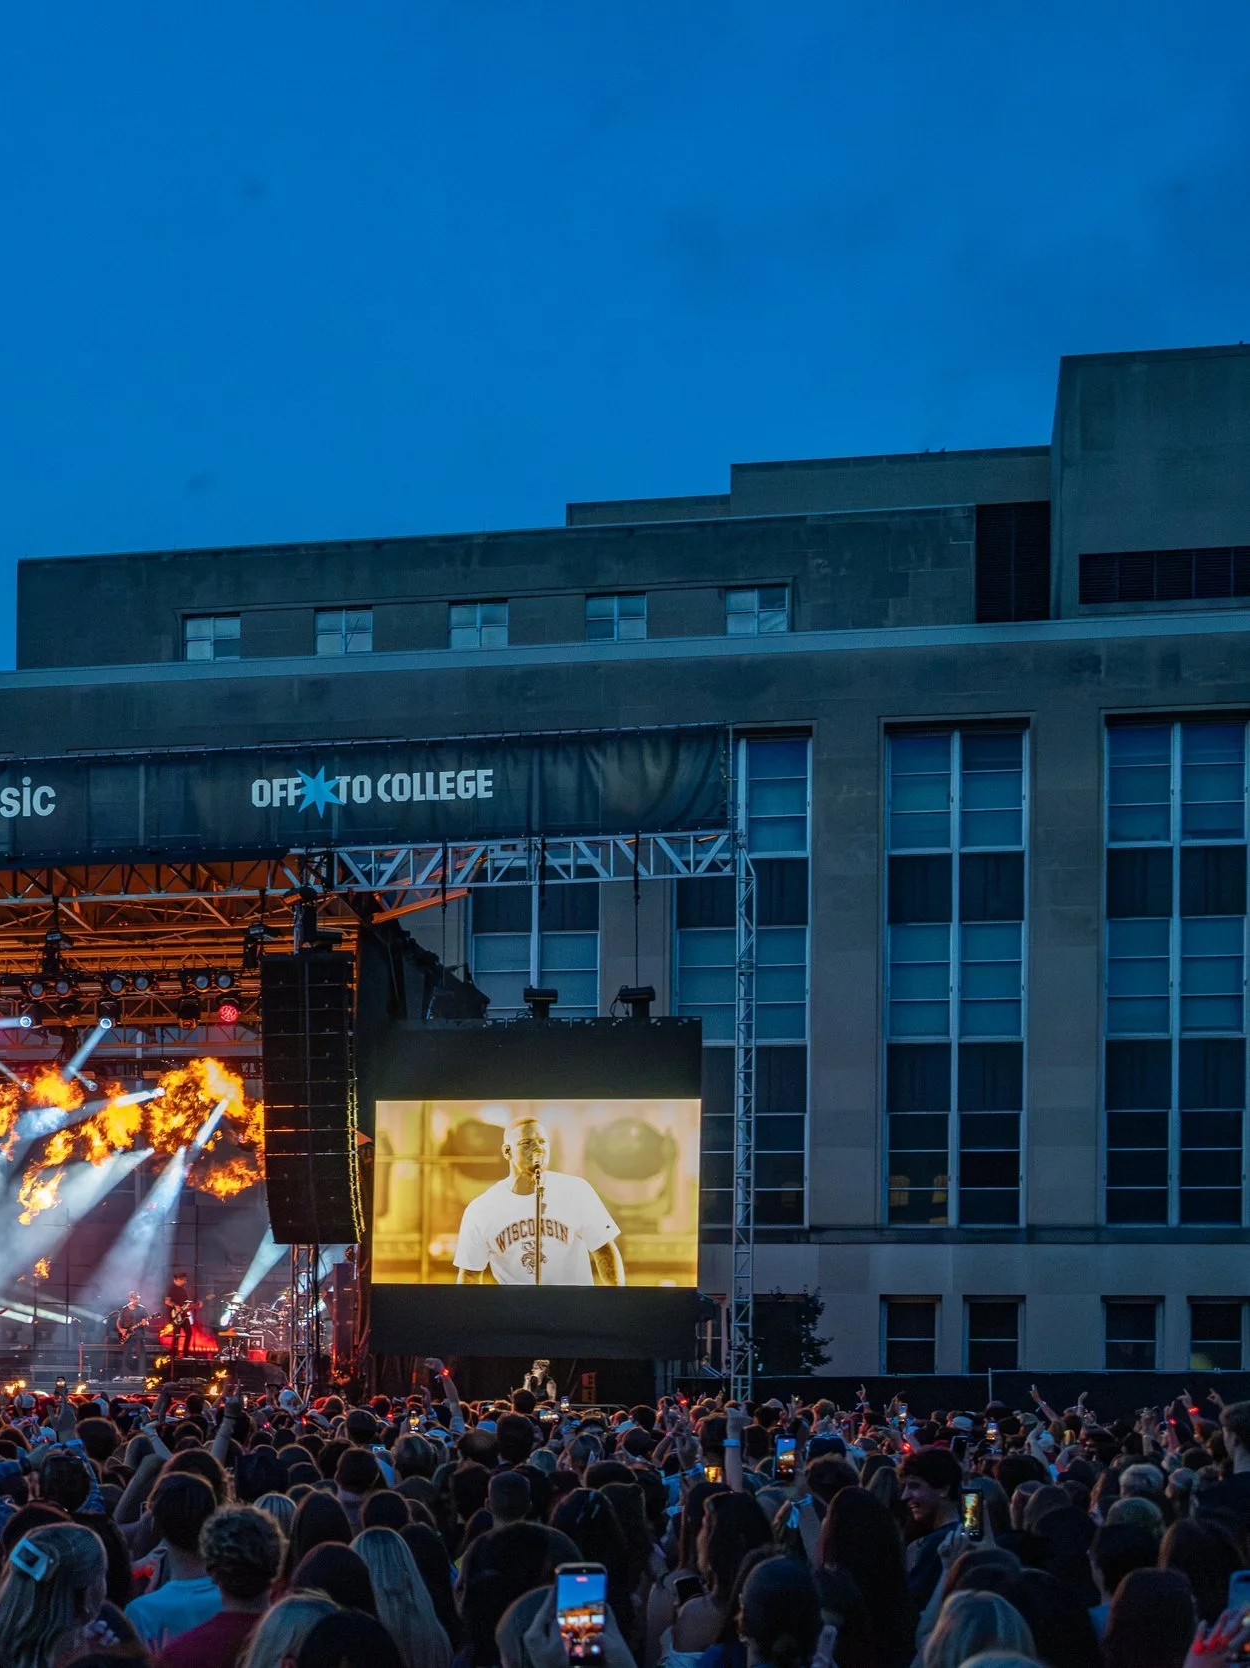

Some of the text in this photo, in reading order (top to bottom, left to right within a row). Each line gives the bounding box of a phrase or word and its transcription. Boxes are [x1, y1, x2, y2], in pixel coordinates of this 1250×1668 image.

[251, 769, 493, 807] OFF TO COLLEGE
[495, 1218, 569, 1253] WISCONSIN
